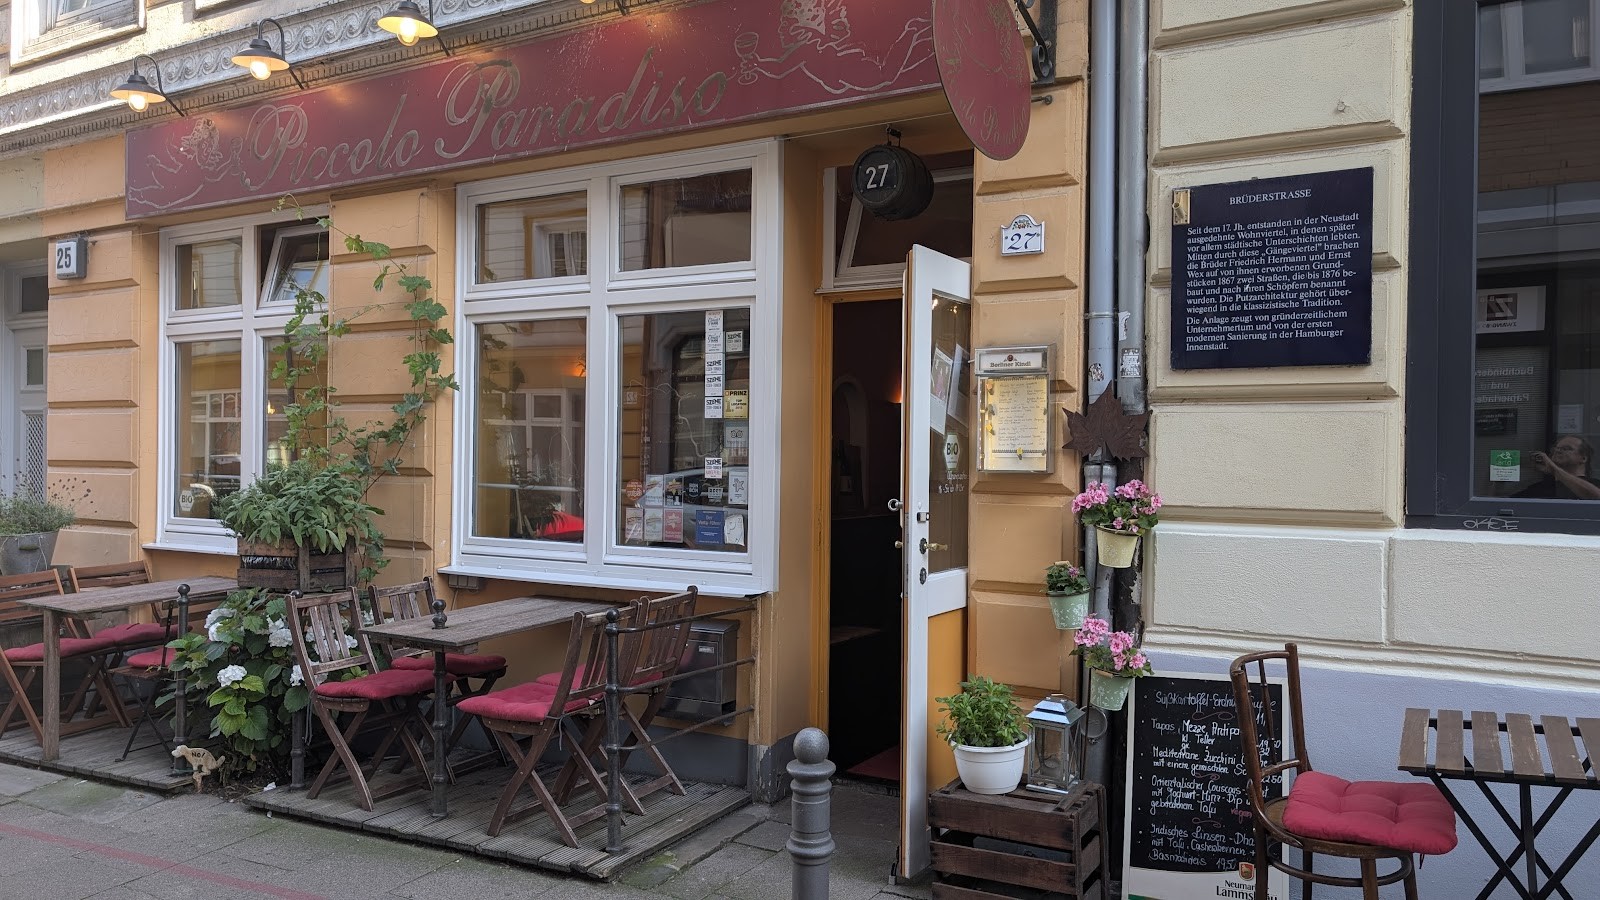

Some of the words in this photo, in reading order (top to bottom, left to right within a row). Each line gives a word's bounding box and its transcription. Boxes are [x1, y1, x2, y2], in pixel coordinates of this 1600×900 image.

[241, 93, 424, 191] Piccolo
[435, 46, 730, 158] Paradiso
[865, 163, 889, 190] 27
[1229, 189, 1312, 205] BRÜDERSTRASSE
[1188, 227, 1202, 235] Seit
[1203, 226, 1221, 234] dem
[1222, 224, 1231, 232] 17.
[1233, 223, 1245, 231] Jh.
[1247, 219, 1292, 230] entstanden
[1295, 217, 1302, 225] in
[1304, 217, 1318, 225] der
[1320, 212, 1359, 223] Neustadt
[1007, 232, 1037, 251] 27
[1187, 234, 1235, 244] ausgedehnte
[1237, 228, 1288, 239] Wohnviertel,
[1291, 227, 1299, 235] in
[1301, 226, 1327, 234] denen
[1329, 223, 1355, 233] später
[1200, 243, 1222, 252] allem
[1223, 240, 1263, 250] städtische
[1266, 235, 1329, 246] Unterschichten
[1331, 232, 1360, 240] lebten.
[56, 247, 71, 269] 25
[1188, 253, 1213, 261] Mitten
[1214, 250, 1237, 259] durch
[1239, 248, 1260, 256] diese
[1325, 241, 1359, 250] brachen
[1187, 261, 1199, 270] die
[1200, 259, 1228, 269] Brüder
[1229, 257, 1266, 267] Friedrich
[1267, 255, 1307, 264] Hermann
[1309, 252, 1325, 261] und
[1328, 251, 1352, 260] Ernst
[1187, 270, 1205, 278] Wex
[1205, 268, 1219, 277] auf
[1237, 267, 1260, 275] ihnen
[1261, 263, 1311, 273] erworbenen
[1313, 260, 1344, 270] Grund-
[1187, 279, 1217, 288] stücken
[1219, 276, 1236, 285] 1867
[1237, 275, 1255, 284] zwei
[1256, 273, 1290, 283] Straßen,
[1292, 272, 1306, 281] die
[1308, 270, 1320, 279] bis
[1321, 269, 1341, 279] 1876
[1343, 269, 1356, 277] be-
[1187, 288, 1205, 296] baut
[1206, 287, 1221, 295] und
[1222, 285, 1242, 294] nach
[1243, 284, 1265, 293] ihren
[1266, 281, 1309, 291] Schöpfern
[1311, 279, 1346, 289] benannt
[1187, 297, 1218, 305] wurden.
[1219, 294, 1234, 303] Die
[1235, 291, 1299, 302] Putzarchitektur
[1299, 289, 1327, 300] gehört
[1329, 288, 1352, 296] über-
[1187, 304, 1218, 315] wiegend
[1220, 303, 1228, 312] in
[1229, 303, 1242, 312] die
[1243, 299, 1300, 311] klassizistische
[1302, 298, 1343, 308] Tradition.
[1186, 316, 1201, 325] Die
[1202, 315, 1229, 325] Anlage
[1230, 314, 1253, 324] zeugt
[1254, 314, 1270, 322] von
[1271, 310, 1348, 322] gründerzeitlichem
[1186, 324, 1255, 334] Unternehmertum
[1256, 322, 1272, 331] und
[1273, 321, 1290, 329] von
[1291, 320, 1305, 329] der
[1306, 319, 1333, 328] ersten
[1186, 334, 1226, 343] modernen
[1227, 331, 1268, 341] Sanierung
[1269, 330, 1278, 339] in
[1279, 330, 1294, 339] der
[1295, 329, 1344, 339] Hamburger
[1186, 342, 1230, 352] Innenstadt.
[1211, 722, 1241, 740] Antipa
[191, 751, 206, 759] No!
[1225, 880, 1256, 891] Neumar
